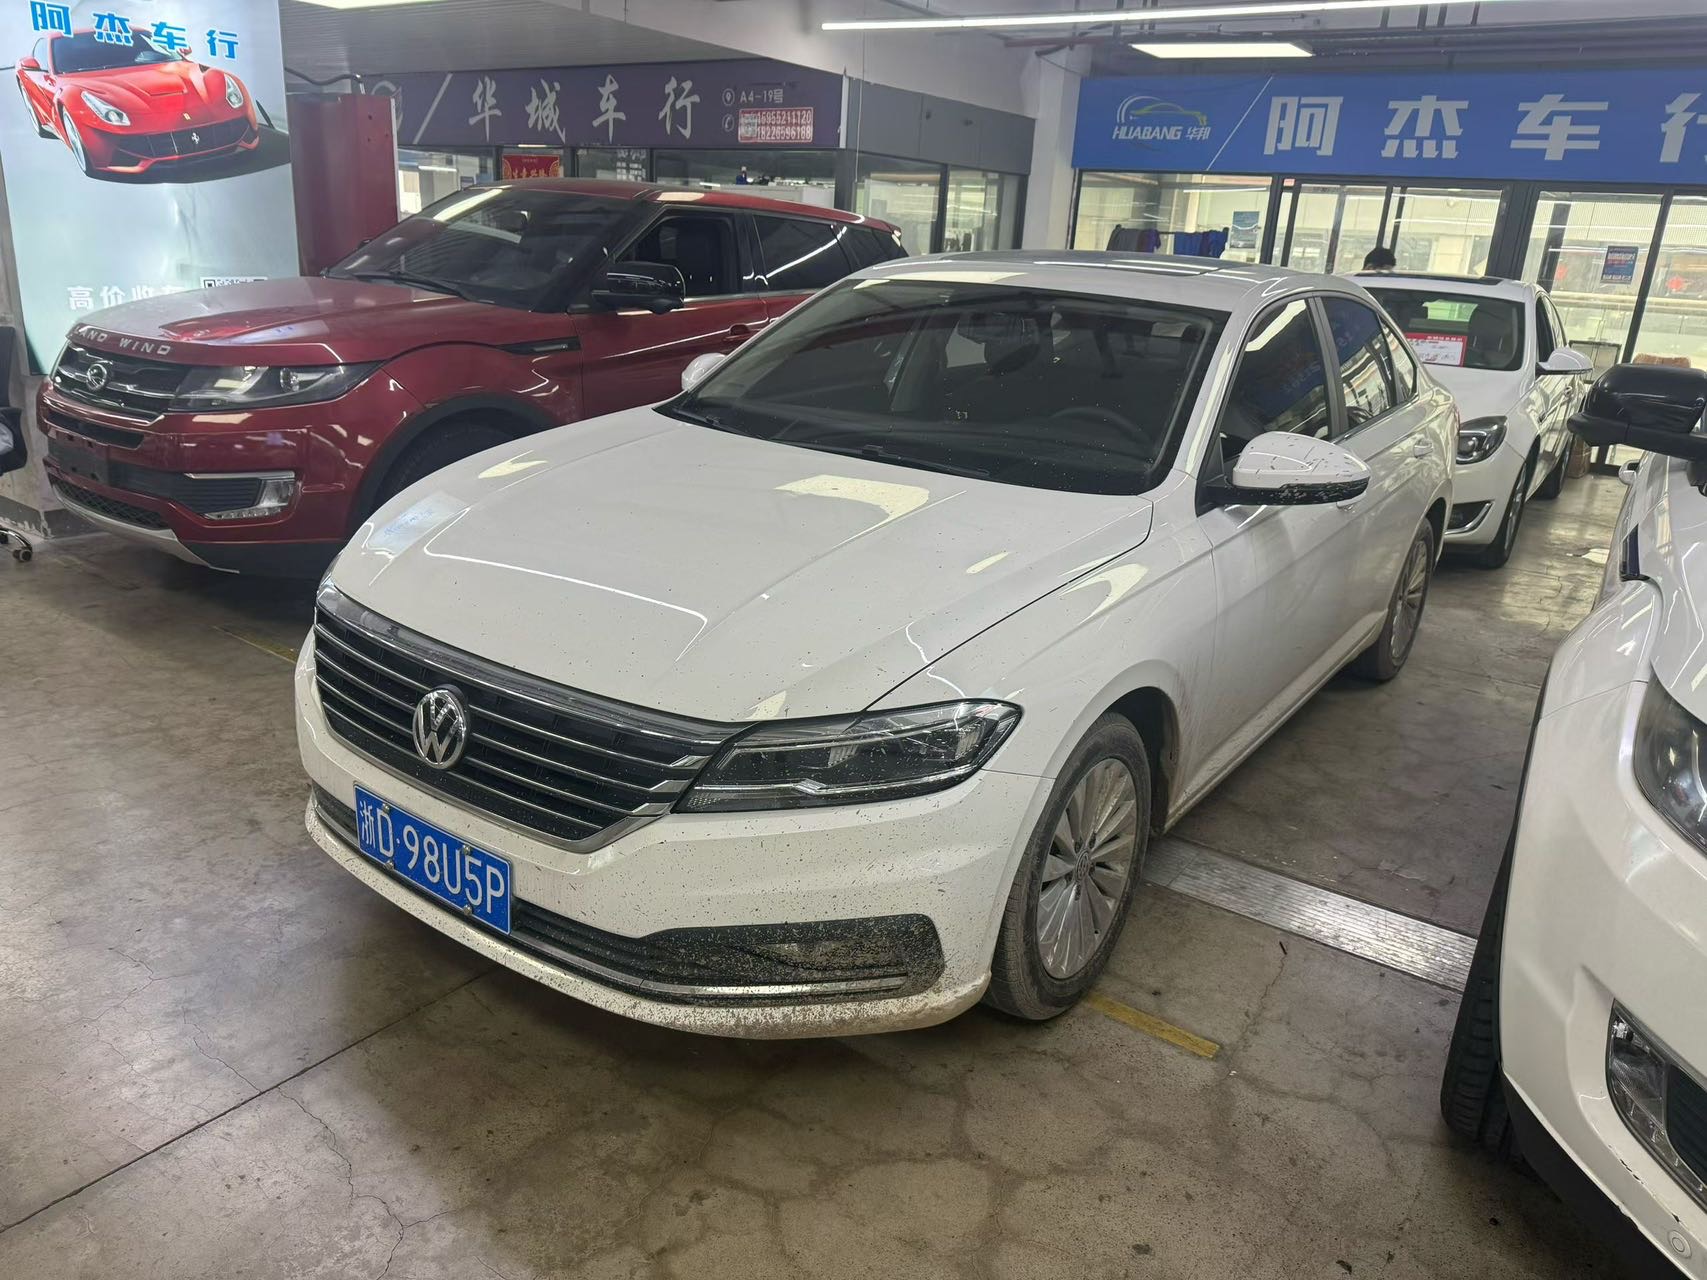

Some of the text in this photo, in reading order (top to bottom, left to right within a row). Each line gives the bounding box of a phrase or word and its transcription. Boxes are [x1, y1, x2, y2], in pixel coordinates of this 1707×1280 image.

[30, 0, 240, 60] 阿杰车行
[468, 75, 701, 145] 华城车行
[1112, 126, 1183, 140] HUABANG
[67, 285, 186, 311] 高价
[118, 337, 171, 355] WIND
